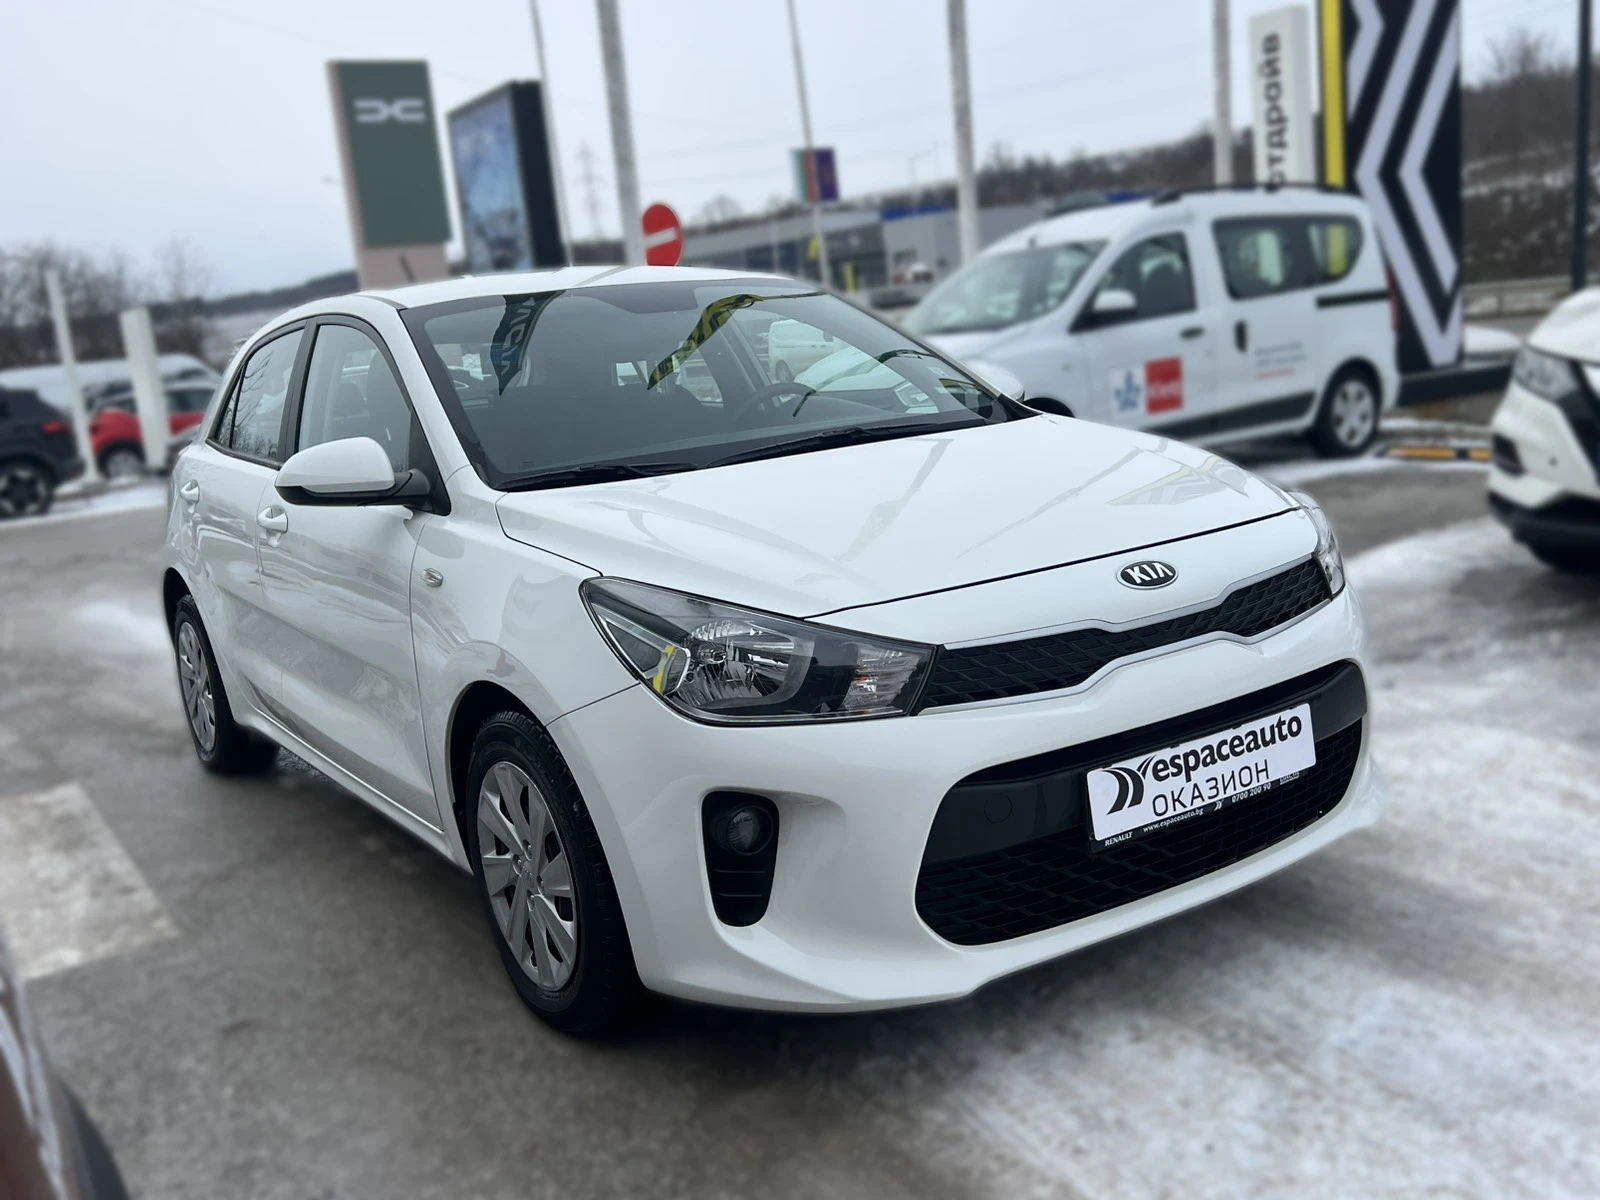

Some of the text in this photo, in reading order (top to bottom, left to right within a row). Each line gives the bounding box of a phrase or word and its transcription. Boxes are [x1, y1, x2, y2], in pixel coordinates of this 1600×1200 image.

[1124, 562, 1174, 584] KIA
[1152, 715, 1302, 782] espaceauto
[1104, 831, 1133, 846] RENAULT
[1142, 807, 1204, 833] www.espaceauto.bg
[1231, 790, 1248, 803] 0700
[1249, 787, 1262, 797] 200
[1152, 759, 1270, 817] ОКАЗИОН
